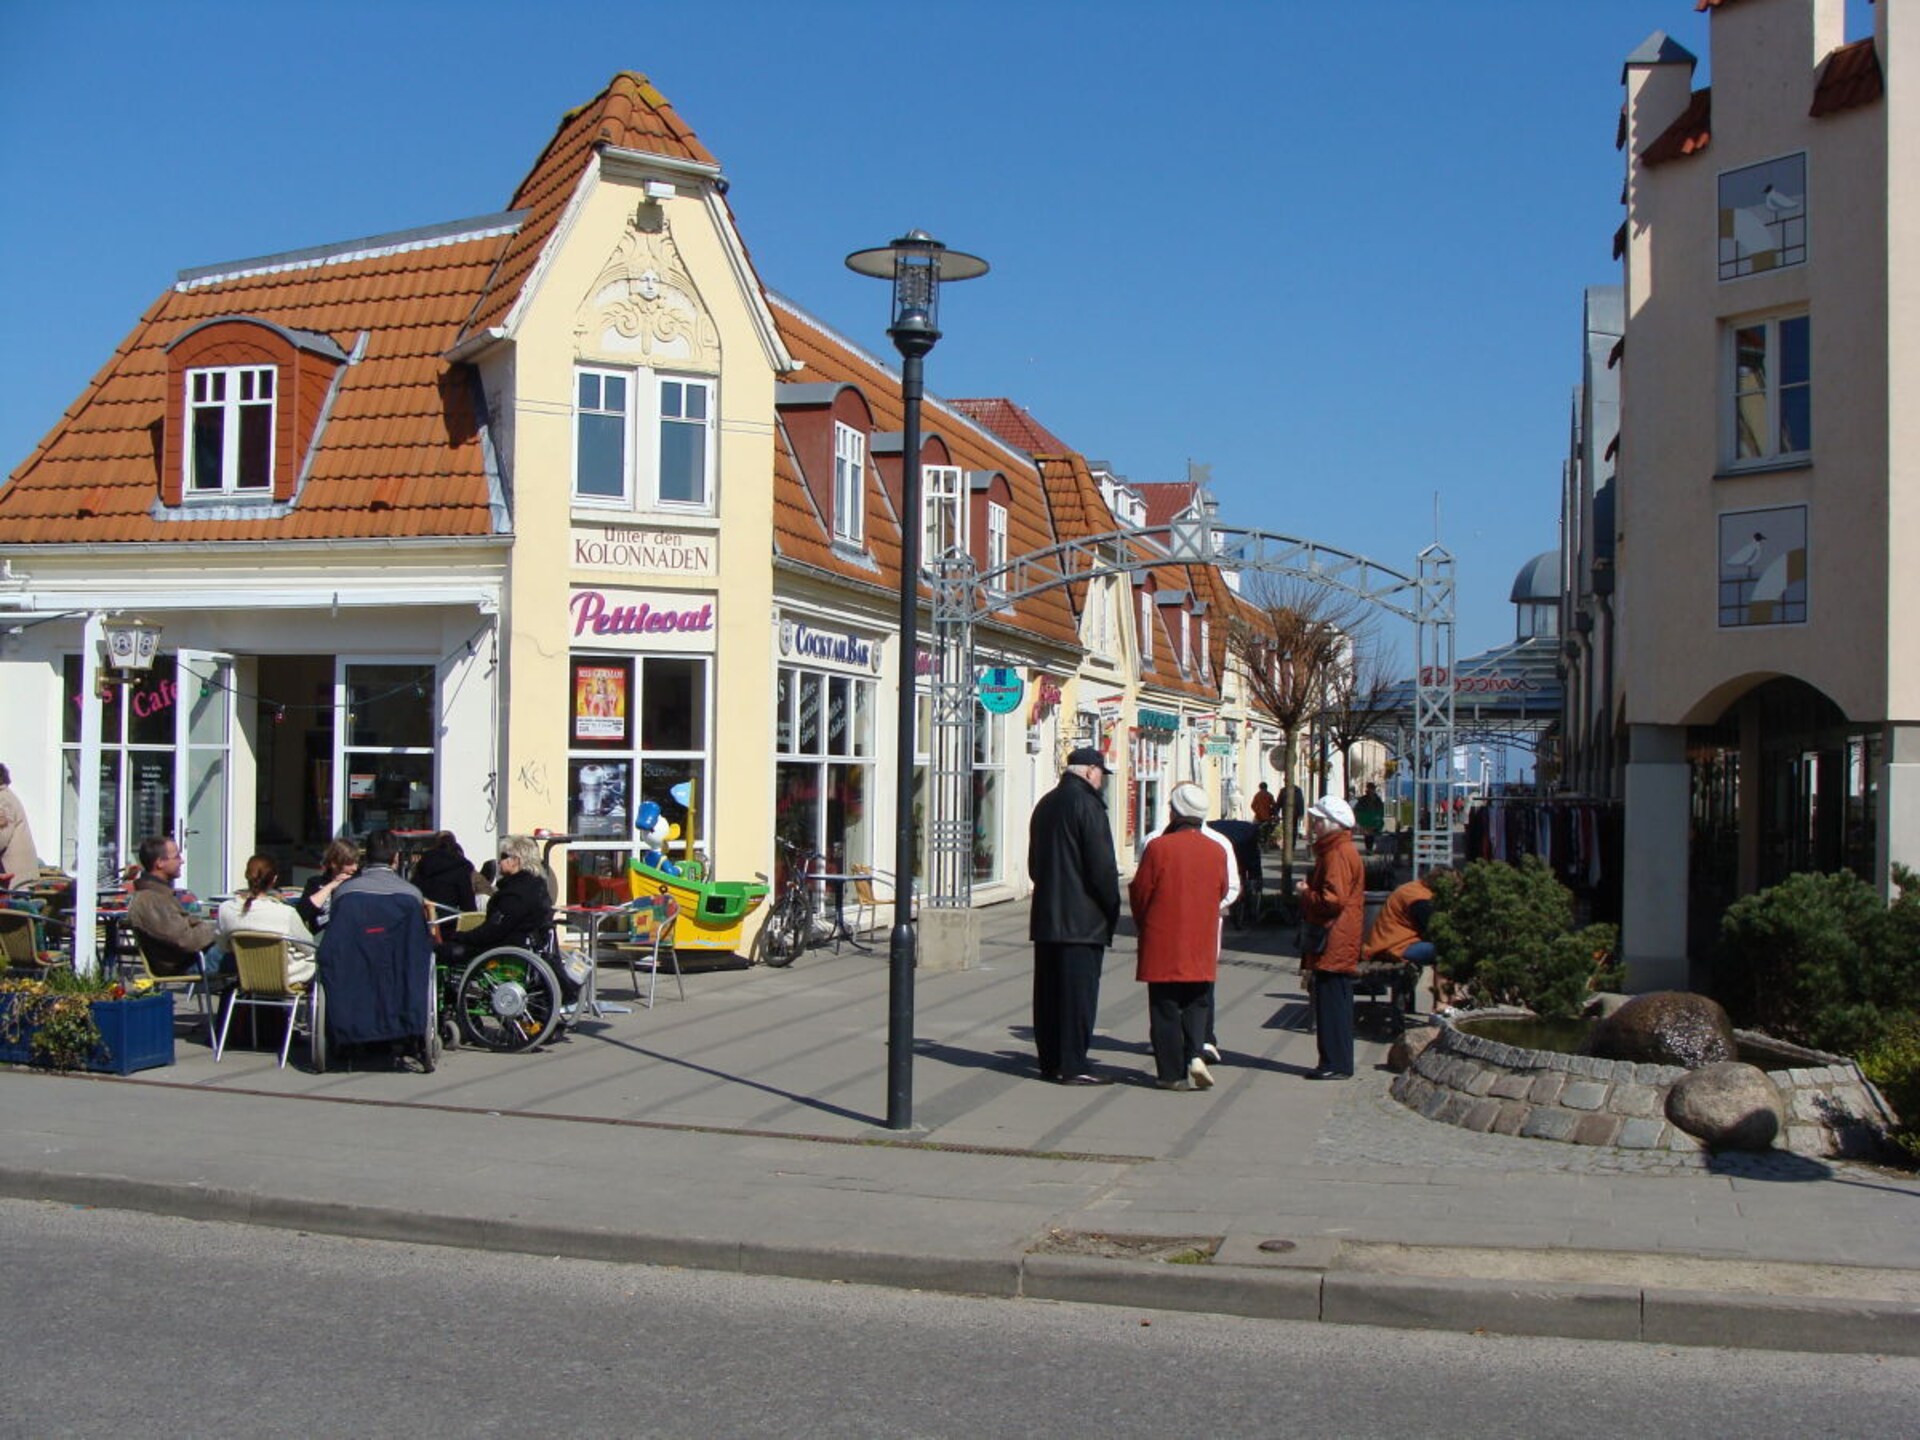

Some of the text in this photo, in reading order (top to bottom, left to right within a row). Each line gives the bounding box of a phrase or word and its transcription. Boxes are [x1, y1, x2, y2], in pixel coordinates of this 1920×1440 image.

[604, 527, 682, 546] Unter den
[575, 539, 709, 570] KOLONNADEN
[569, 591, 714, 637] Petticoat
